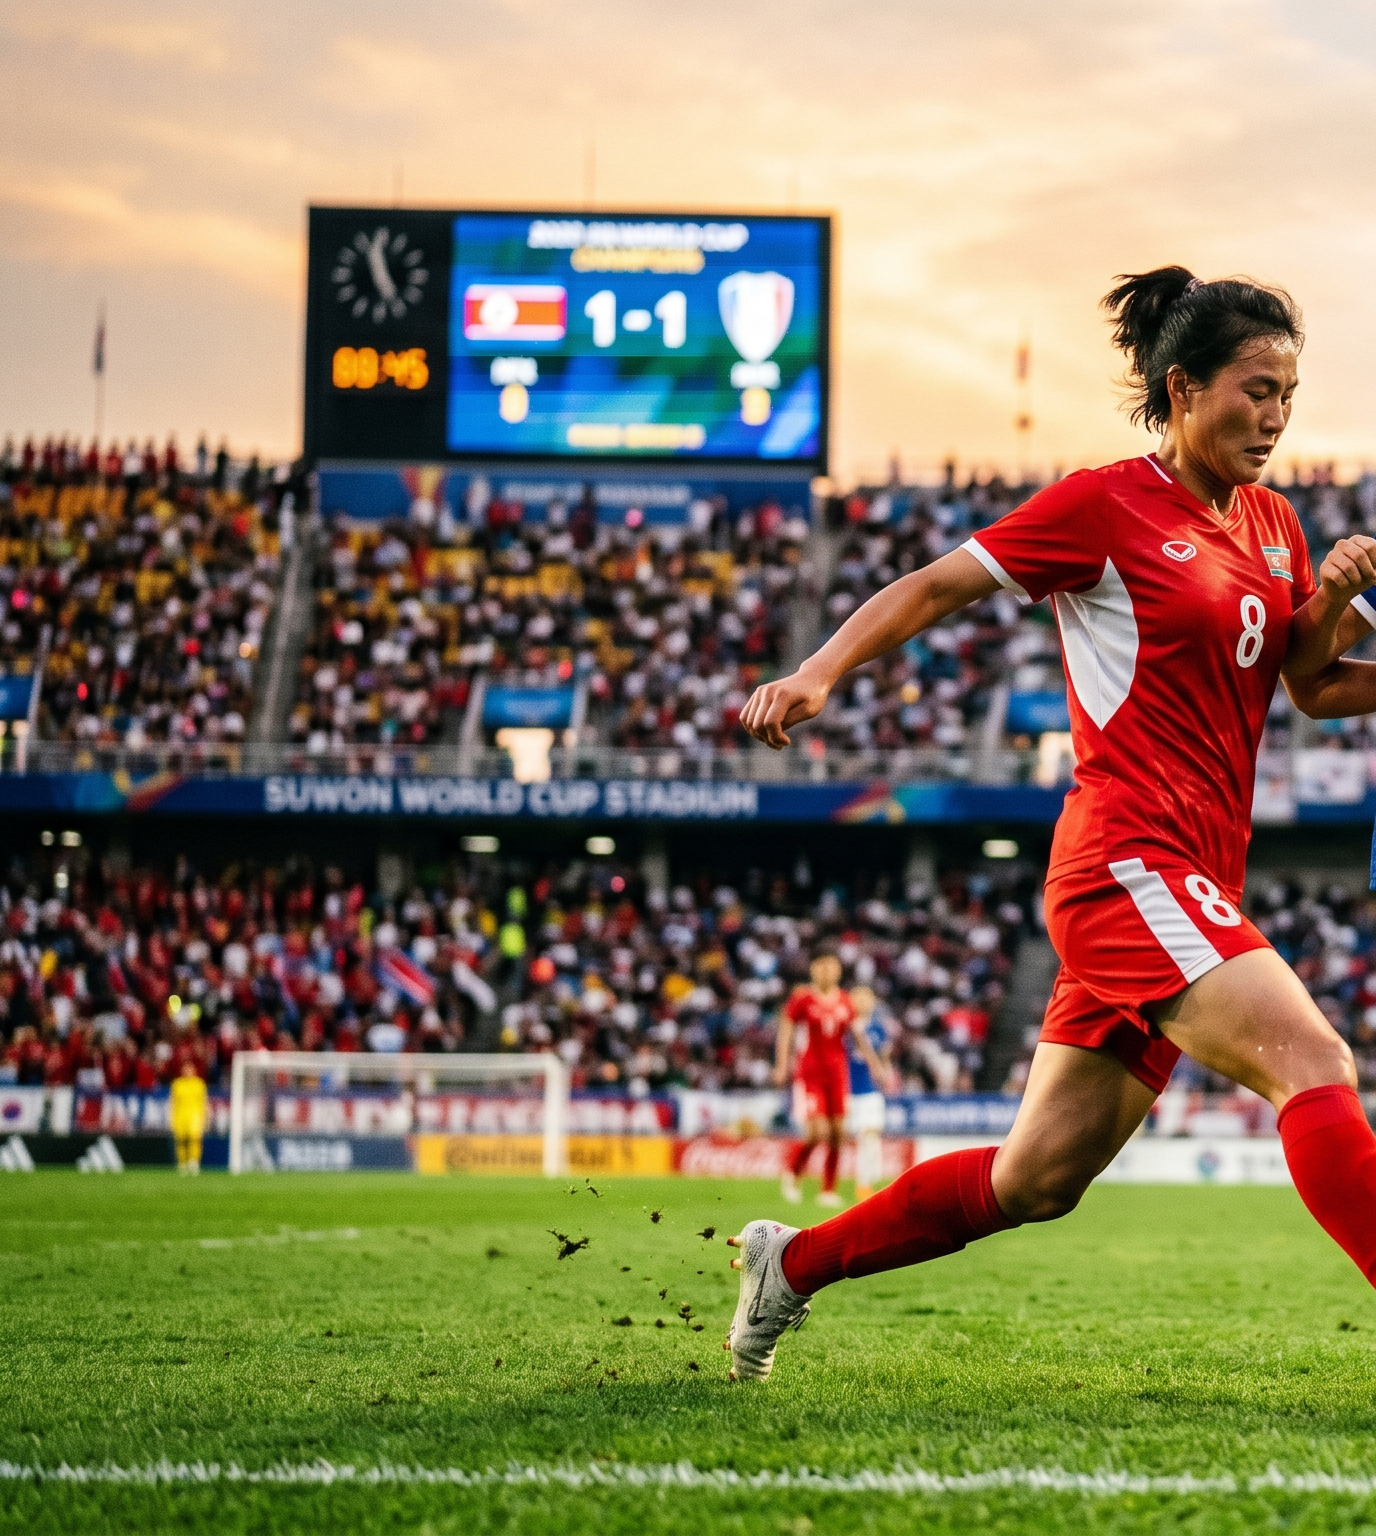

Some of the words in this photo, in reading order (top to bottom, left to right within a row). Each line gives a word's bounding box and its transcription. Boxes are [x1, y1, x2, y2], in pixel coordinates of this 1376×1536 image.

[584, 289, 687, 349] 1-1
[1236, 594, 1266, 668] 8
[264, 777, 394, 814] SUWON
[399, 779, 524, 816] WORLD
[527, 780, 599, 817] CUP
[604, 781, 760, 818] STADIUM
[1184, 874, 1242, 927] 8
